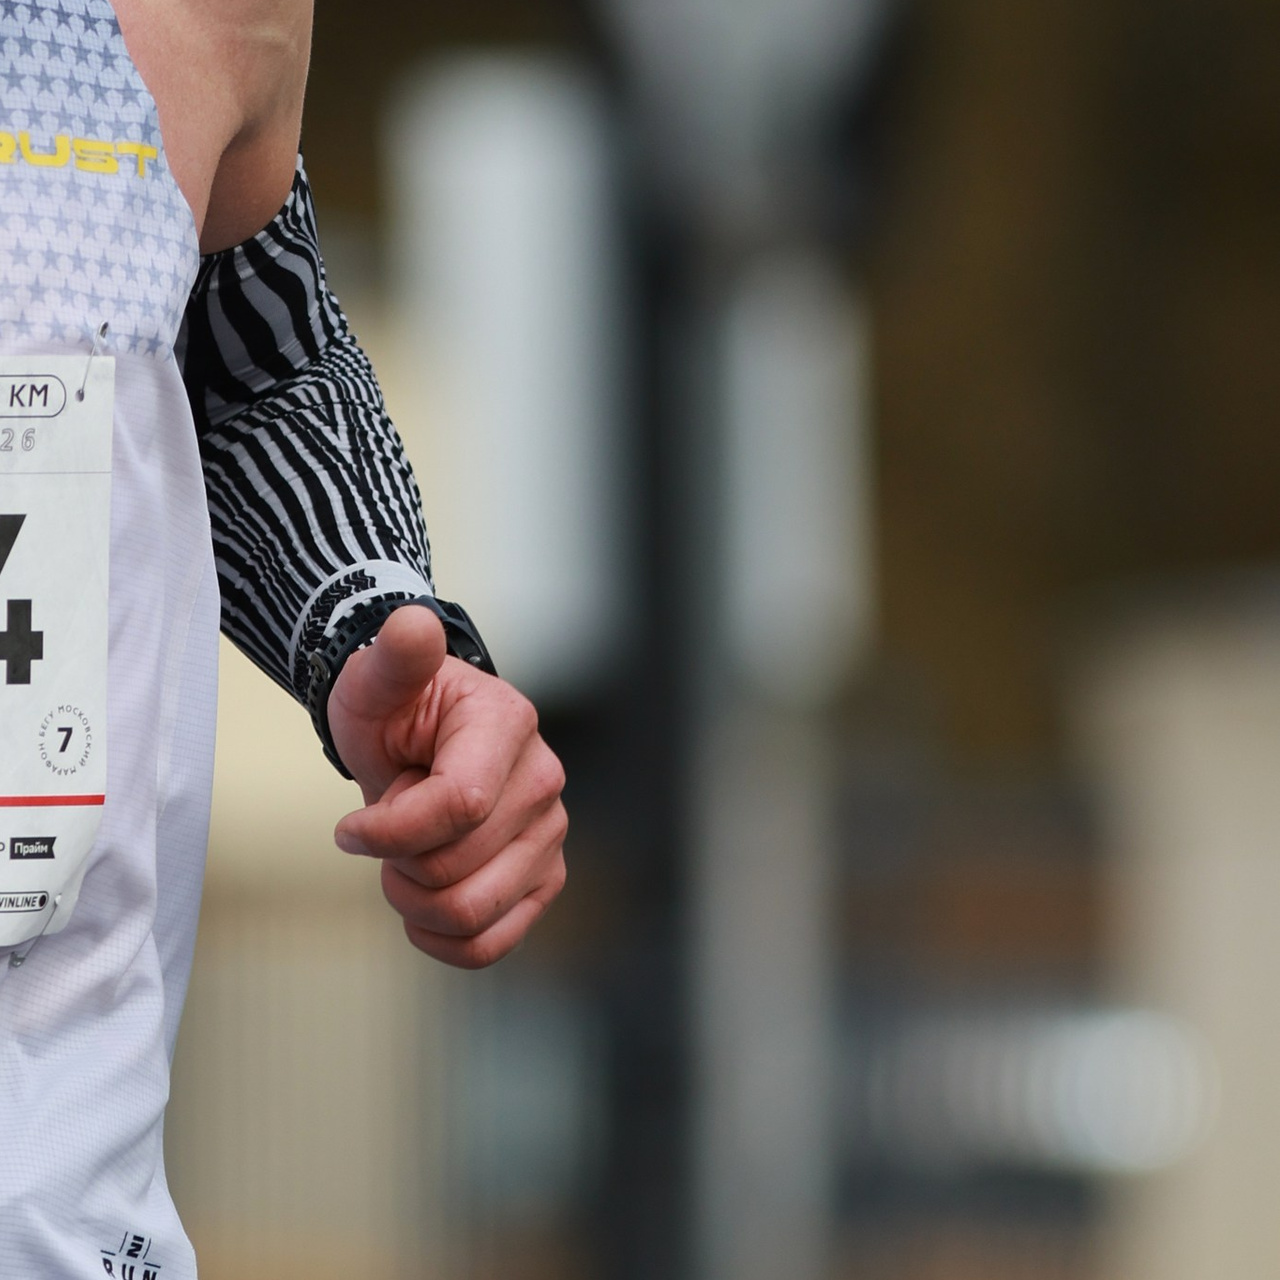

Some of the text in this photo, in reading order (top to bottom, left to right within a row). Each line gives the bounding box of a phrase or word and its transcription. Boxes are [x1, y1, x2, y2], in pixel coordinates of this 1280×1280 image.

[9, 383, 49, 408] КМ
[57, 726, 73, 753] 7
[58, 704, 92, 767] МОСКОВСКИЙ
[38, 742, 77, 776] МАРАФОН
[14, 841, 48, 856] Прайм
[126, 1234, 145, 1259] IN
